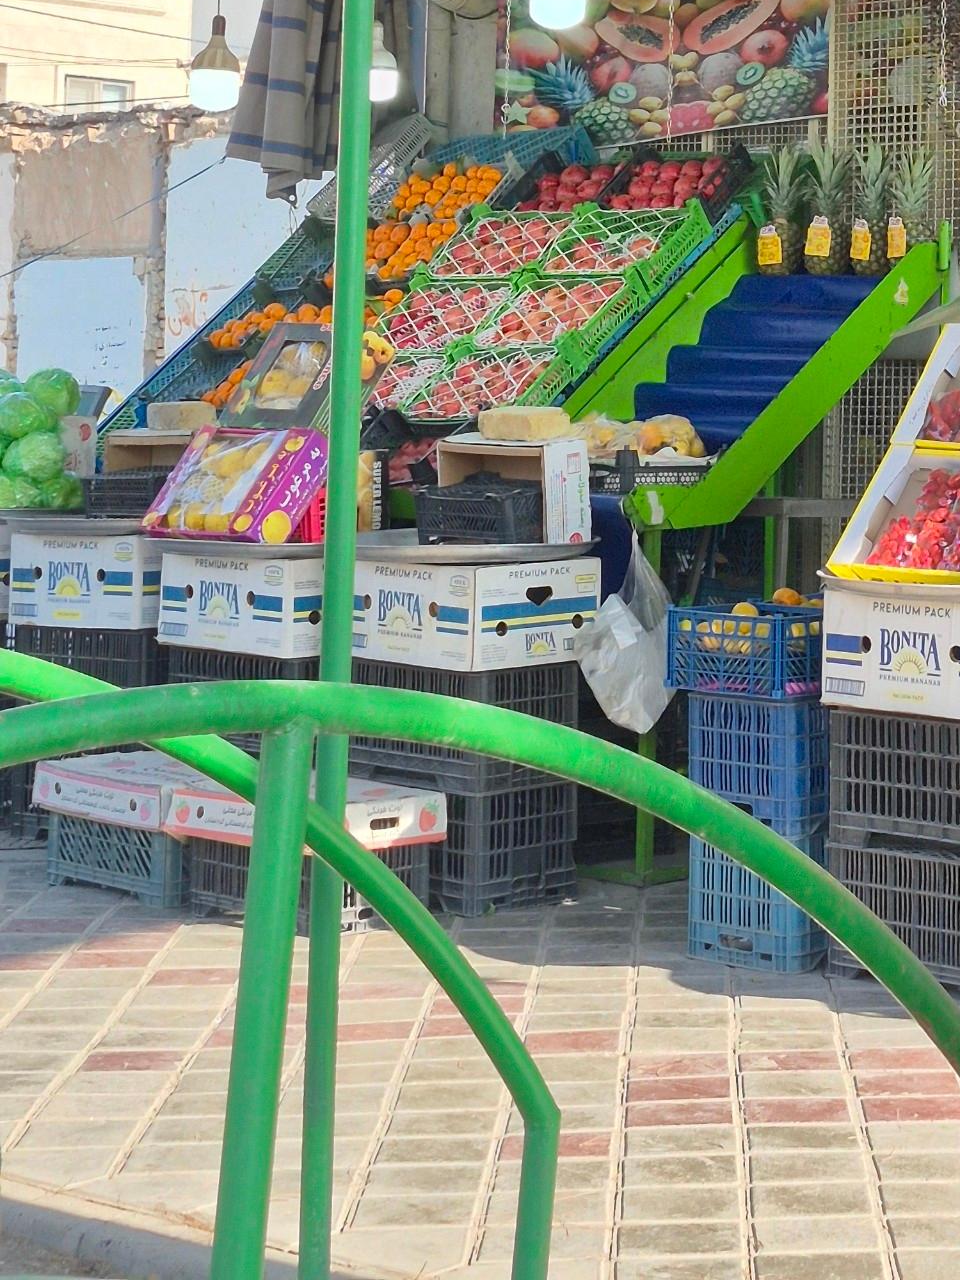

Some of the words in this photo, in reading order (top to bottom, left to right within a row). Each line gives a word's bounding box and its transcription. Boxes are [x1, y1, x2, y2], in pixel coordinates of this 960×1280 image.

[372, 460, 382, 498] SUPER
[43, 539, 78, 550] PREMIUM
[79, 540, 99, 550] PACK
[194, 557, 229, 569] PREMIUM
[229, 561, 249, 571] PACK
[374, 565, 411, 578] PREMIUM
[412, 569, 433, 581] PACK
[508, 569, 548, 579] PREMIUM
[550, 566, 571, 575] PACK
[47, 560, 91, 592] BONITA
[198, 579, 240, 615] BONITA
[377, 588, 423, 627] BONITA
[872, 601, 921, 616] PREMIUM
[924, 606, 951, 619] PACK
[525, 631, 556, 652] BONITA
[879, 627, 941, 671] BONITA
